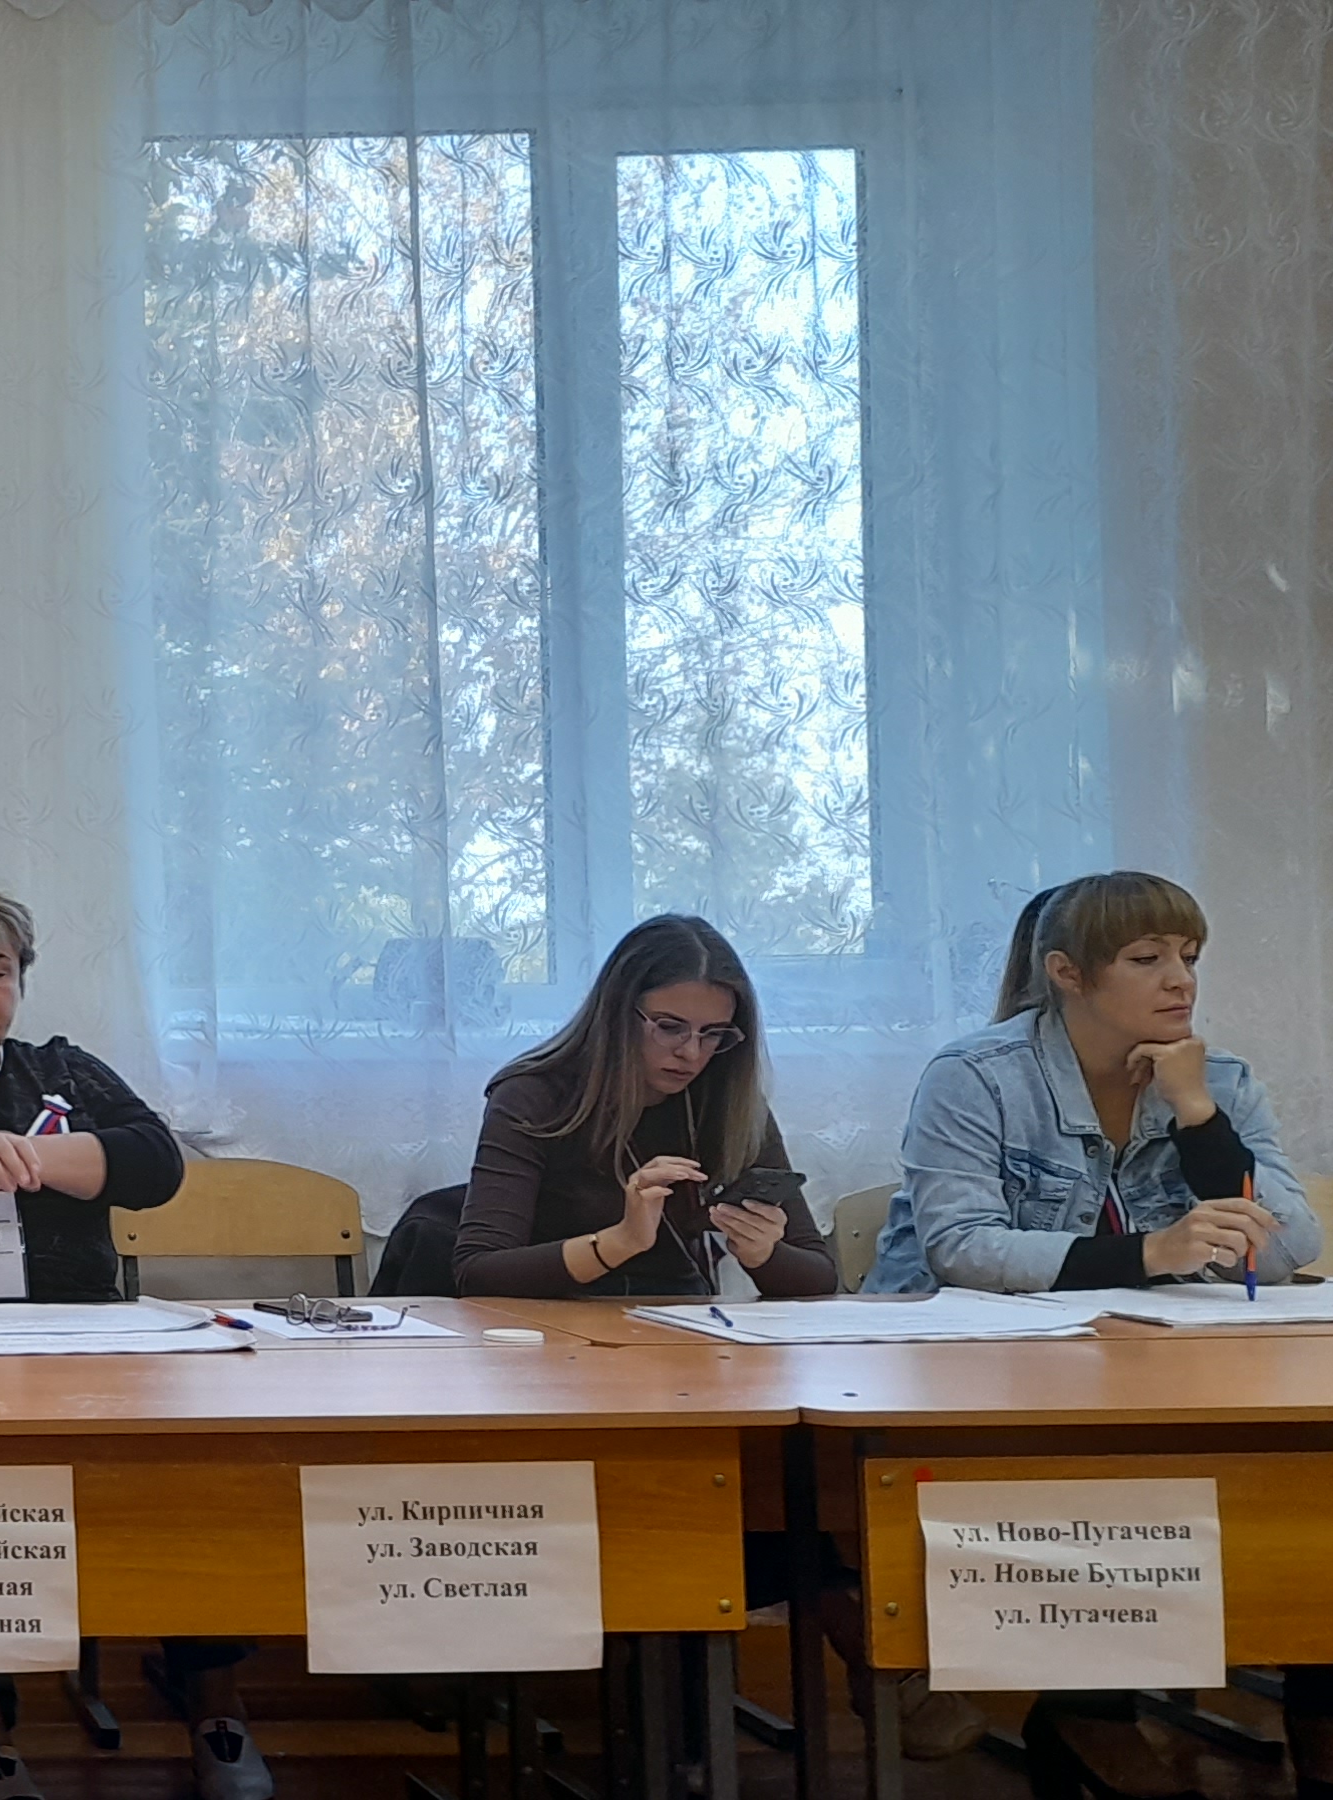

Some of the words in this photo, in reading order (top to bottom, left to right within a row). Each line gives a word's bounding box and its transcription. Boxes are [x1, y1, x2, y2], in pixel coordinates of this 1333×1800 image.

[357, 1506, 394, 1527] ул.
[401, 1500, 545, 1526] Кирпичная
[952, 1527, 990, 1548] ул.
[996, 1520, 1192, 1547] Ново-Пугачева
[366, 1543, 403, 1564] ул.
[409, 1537, 539, 1559] Заводская
[949, 1568, 986, 1589] ул.
[993, 1562, 1080, 1584] Новые
[1087, 1562, 1201, 1589] Бутырки
[378, 1583, 415, 1605] ул.
[423, 1577, 528, 1599] Светлая
[994, 1608, 1031, 1631] ул.
[1039, 1603, 1159, 1630] Пугачева
